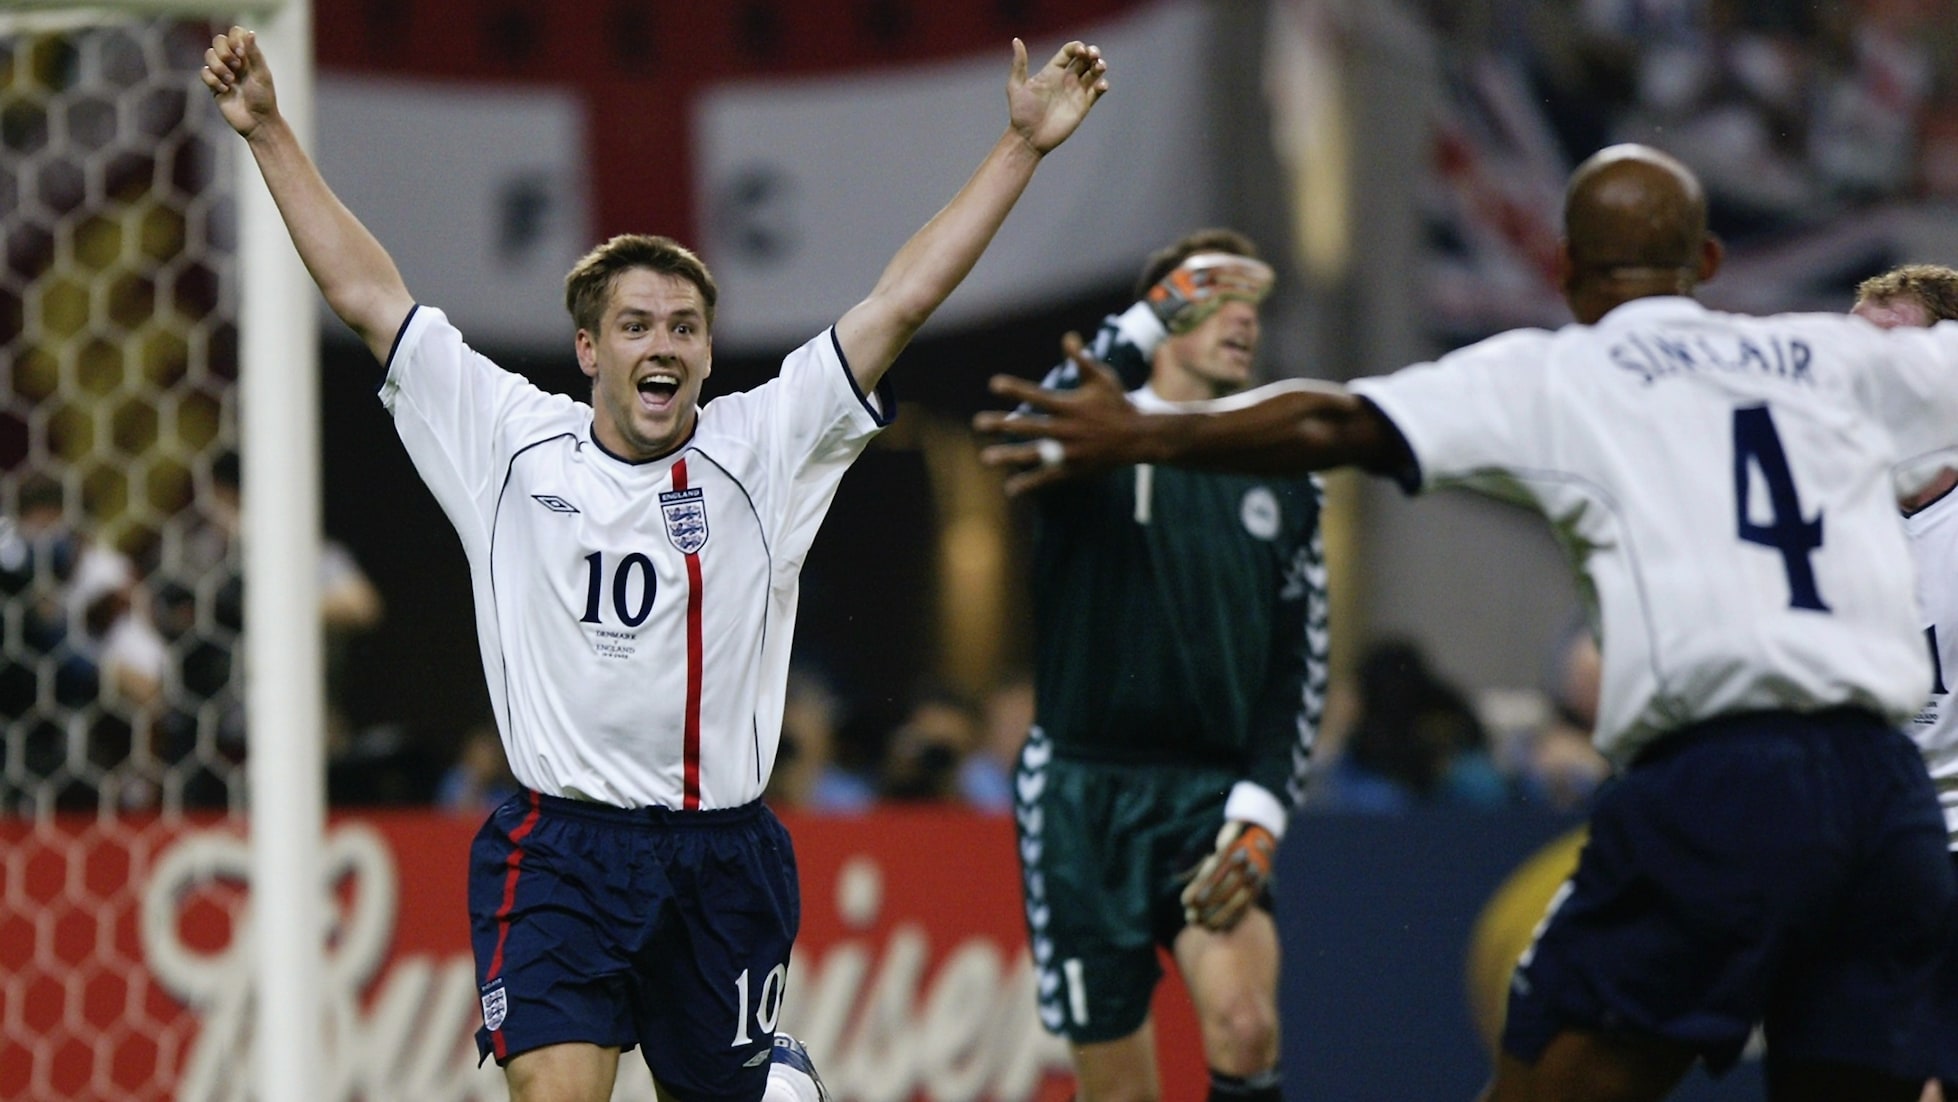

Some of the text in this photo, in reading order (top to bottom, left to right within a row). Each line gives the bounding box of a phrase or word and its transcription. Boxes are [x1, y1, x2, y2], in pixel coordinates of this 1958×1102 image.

[661, 489, 701, 501] ENGLAND
[1134, 463, 1153, 524] 1
[1732, 401, 1834, 614] 4
[580, 550, 657, 628] 10
[596, 643, 636, 654] ENGLAND
[138, 818, 1076, 1102] Buiser
[1063, 957, 1088, 1027] 1
[731, 962, 787, 1048] 10
